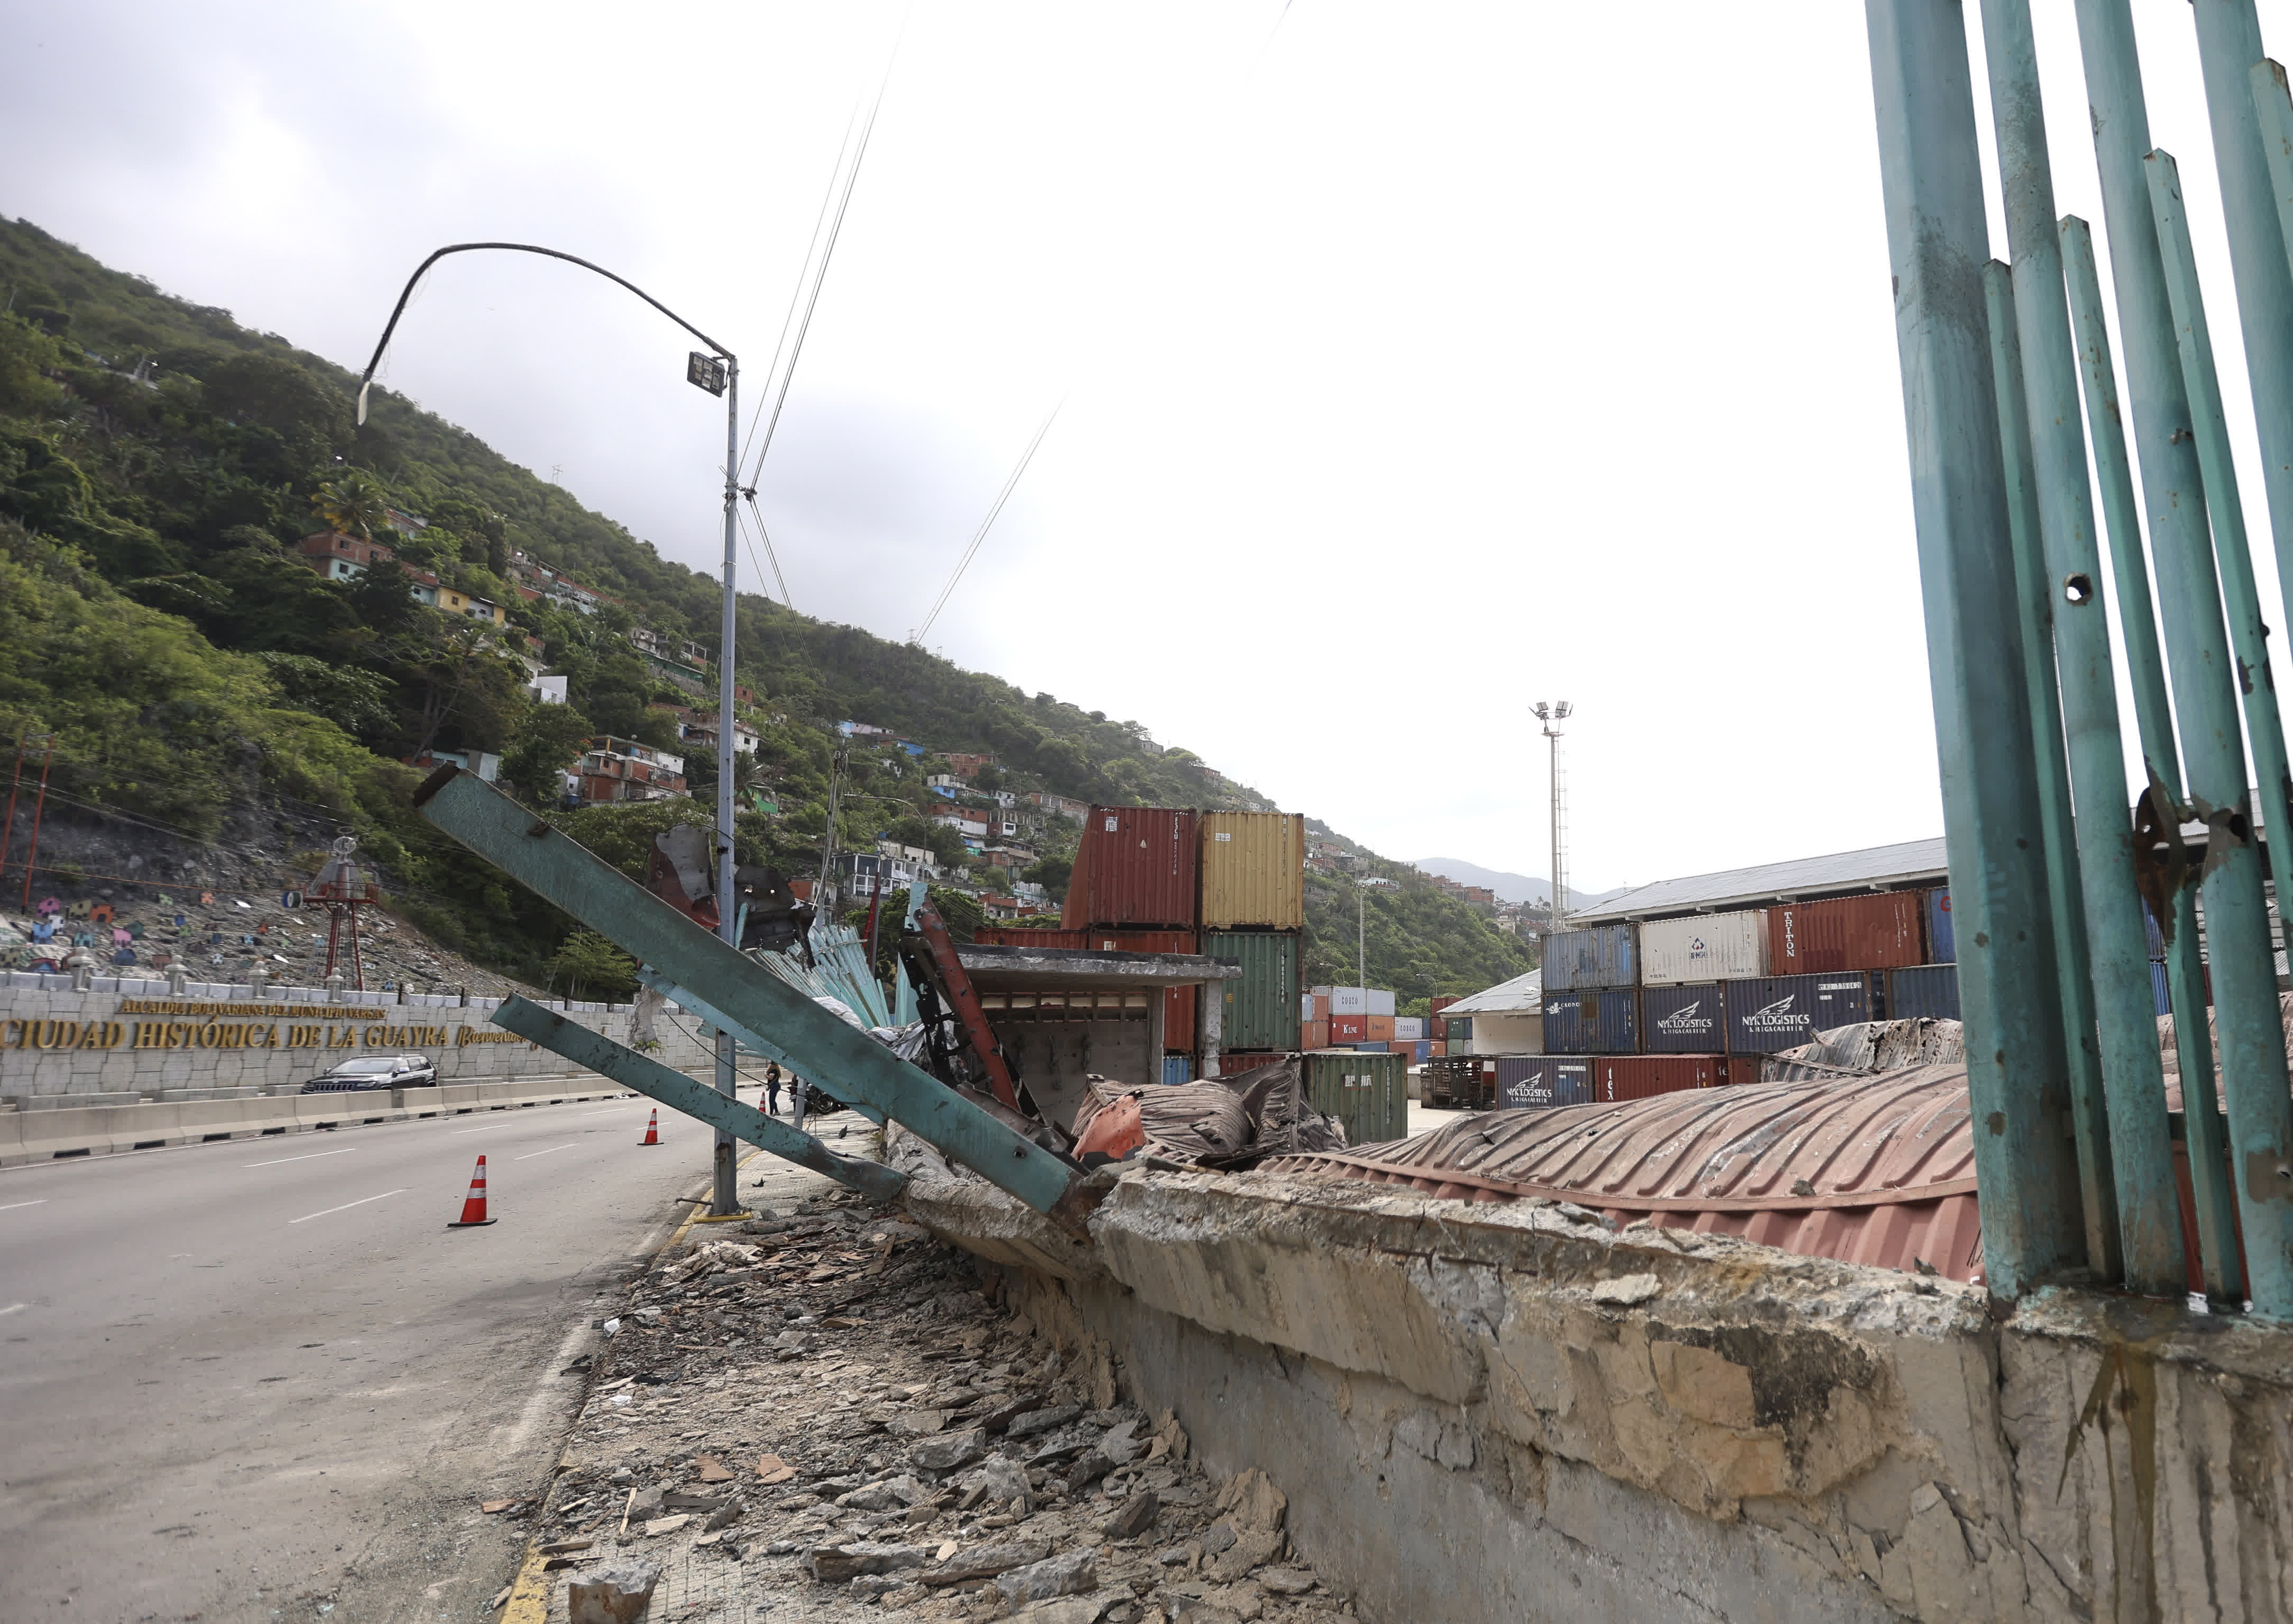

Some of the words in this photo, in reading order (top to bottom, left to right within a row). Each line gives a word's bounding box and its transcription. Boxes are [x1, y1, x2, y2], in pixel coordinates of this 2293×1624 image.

[1784, 912, 1795, 957] TRITON
[267, 1004, 288, 1016] DEL
[291, 1005, 343, 1018] MUNICIPIO
[348, 1008, 385, 1019] VARGAS
[1657, 1019, 1672, 1028] NYK
[1673, 1019, 1712, 1028] LOGISTICS
[1742, 1016, 1761, 1026] NYK
[1762, 1014, 1810, 1025] LOGISTICS
[0, 1019, 126, 1049] CIUDAD
[133, 1015, 281, 1049] HISTÓRICA
[288, 1025, 323, 1048] DE
[327, 1025, 358, 1048] LA
[366, 1025, 449, 1047] GUAYRA
[1520, 1088, 1552, 1097] LOGISTICS
